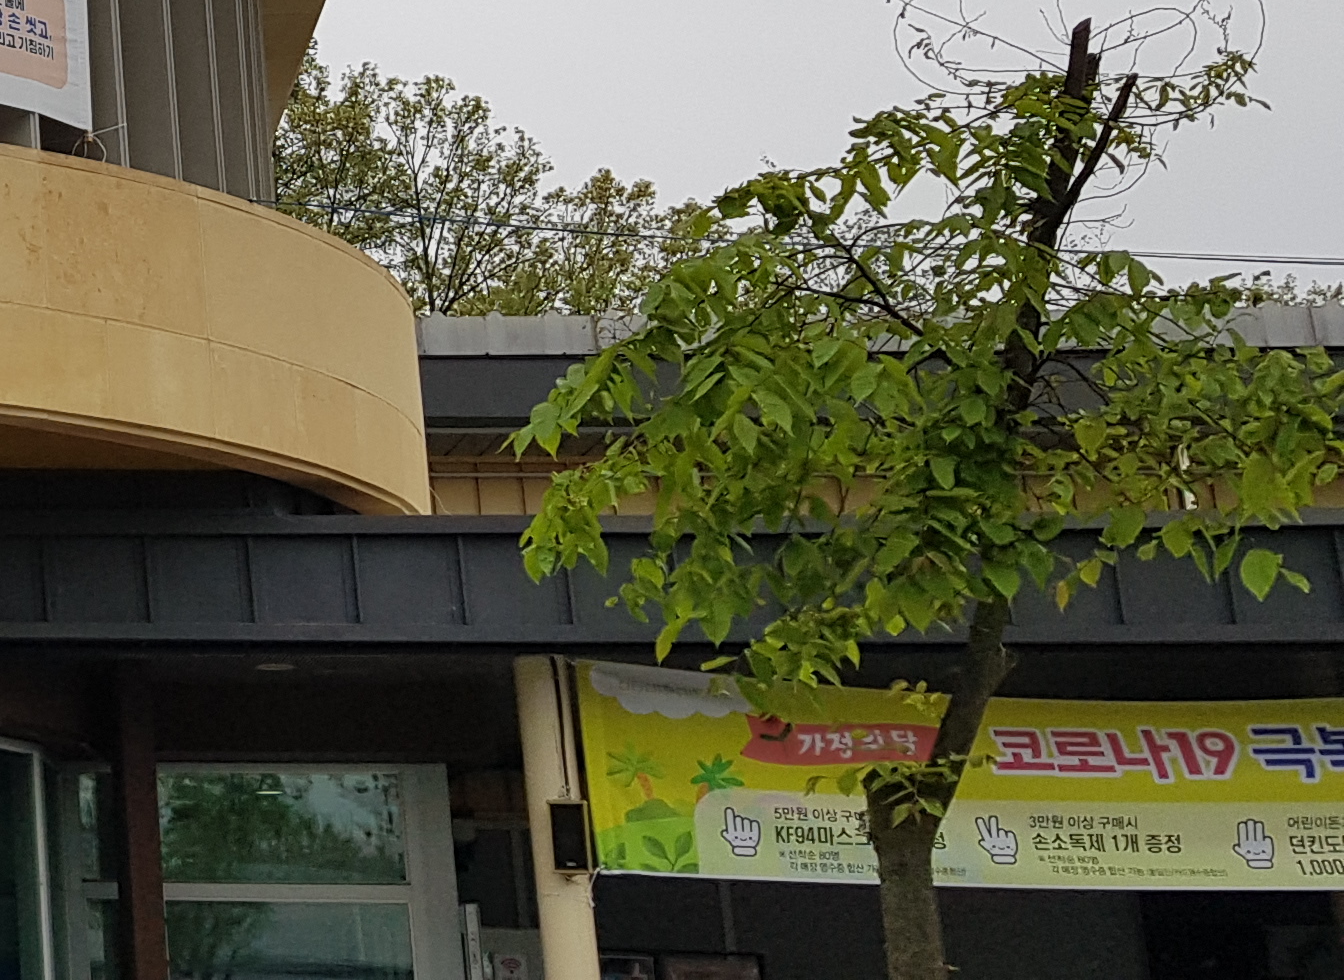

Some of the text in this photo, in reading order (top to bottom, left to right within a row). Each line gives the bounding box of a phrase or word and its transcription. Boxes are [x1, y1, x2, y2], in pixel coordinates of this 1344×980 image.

[7, 12, 21, 32] 손
[18, 36, 55, 61] 기침하기
[992, 727, 1236, 781] 코로나19
[773, 806, 808, 821] 5만원
[812, 808, 838, 823] 이상
[1028, 815, 1139, 830] 3만원 이상 구매시
[1287, 815, 1344, 830] 어린이돈
[1032, 833, 1182, 854] 손소독제 1개 증정
[1288, 835, 1344, 854] 던킨도
